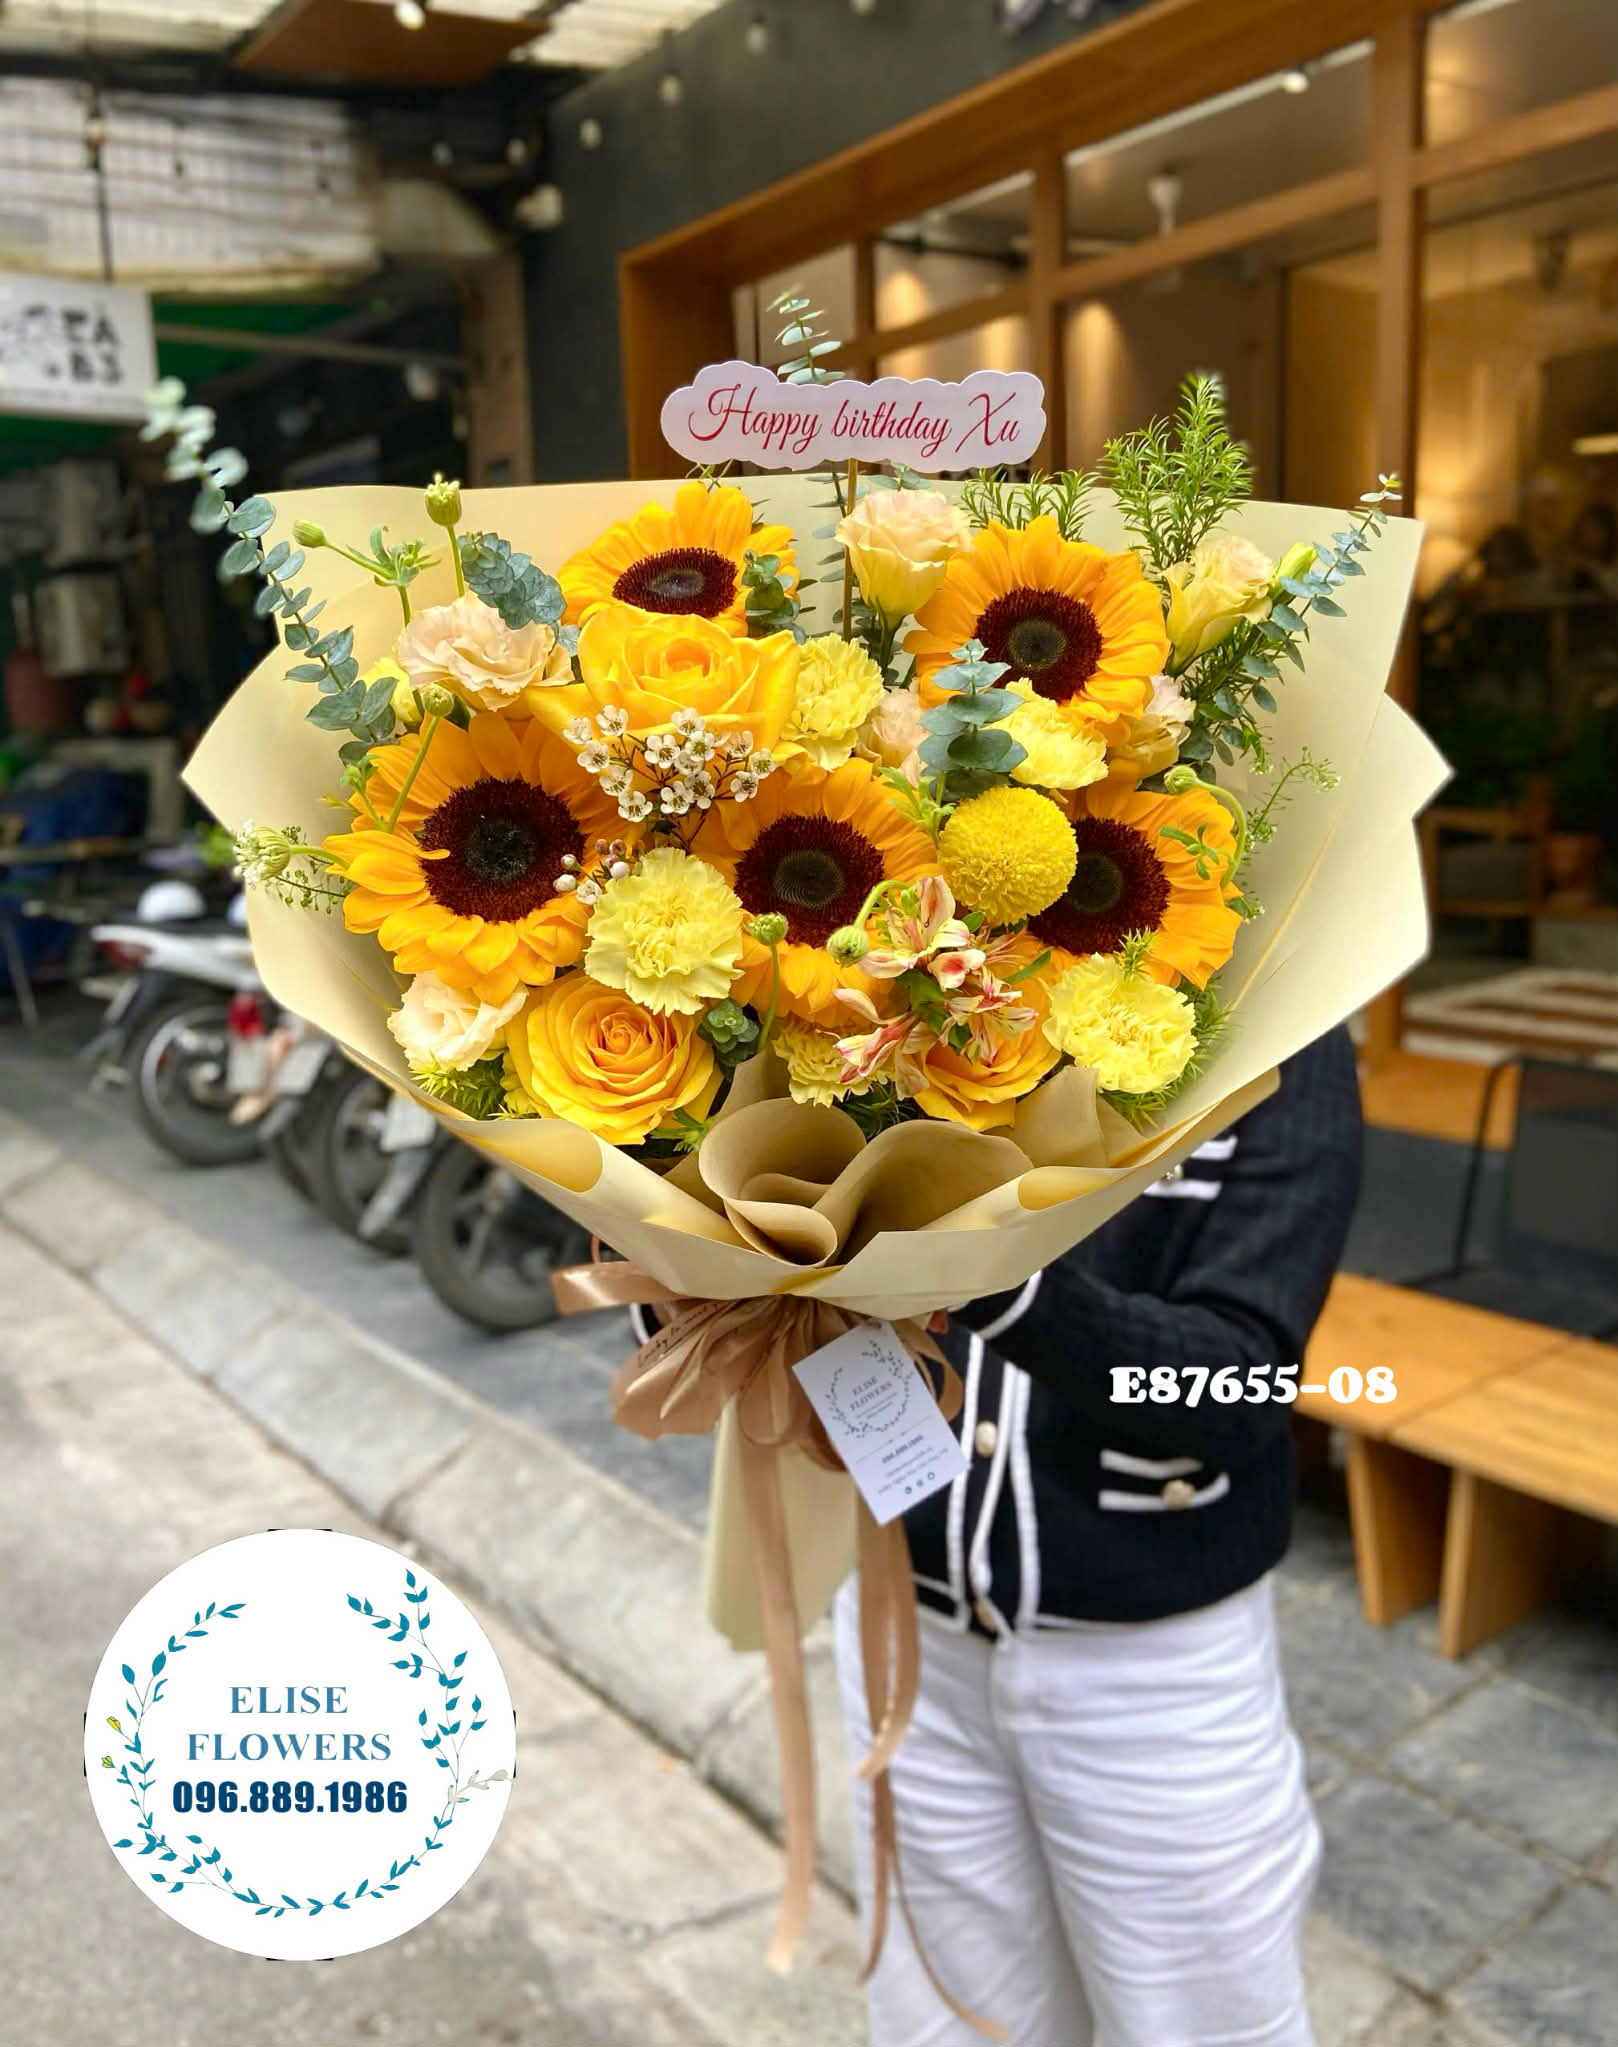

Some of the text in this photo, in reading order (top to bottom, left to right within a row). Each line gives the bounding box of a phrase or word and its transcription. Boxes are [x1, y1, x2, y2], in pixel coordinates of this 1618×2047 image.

[688, 383, 1021, 458] Happy birthday Xu
